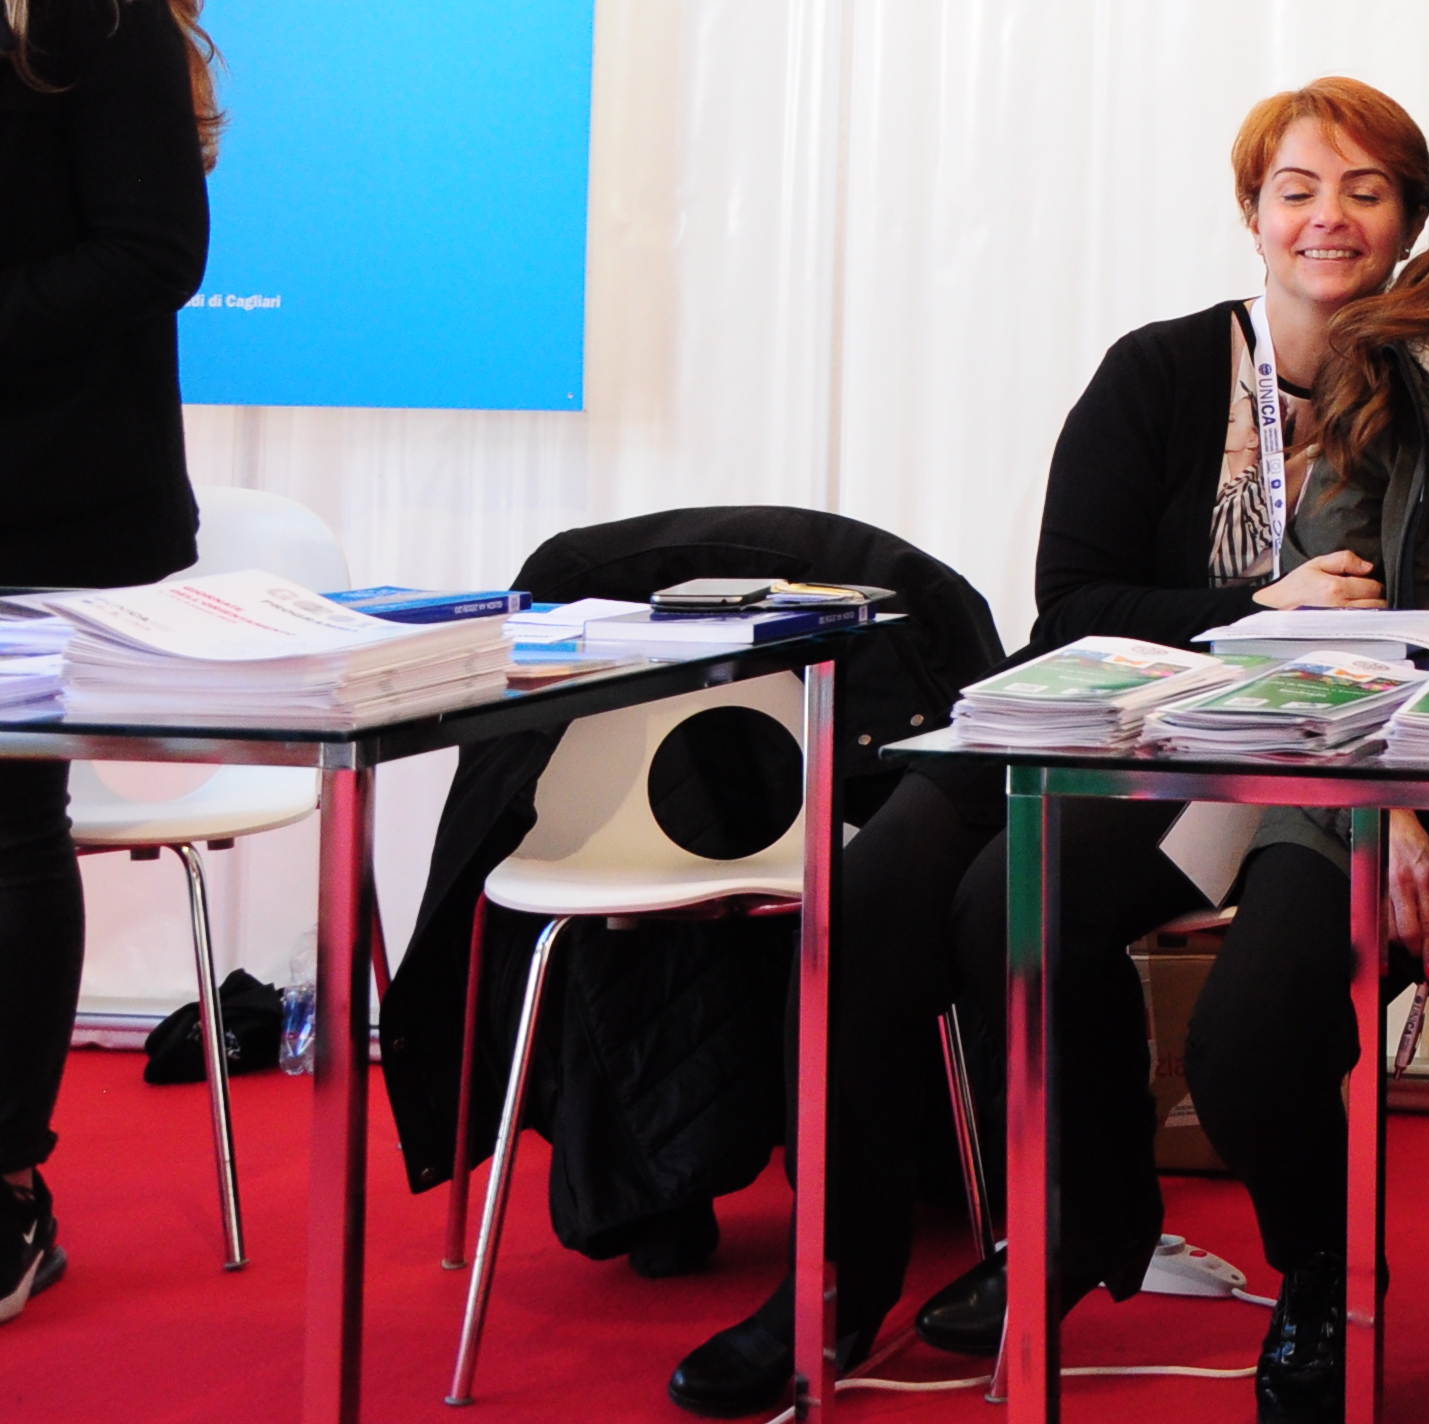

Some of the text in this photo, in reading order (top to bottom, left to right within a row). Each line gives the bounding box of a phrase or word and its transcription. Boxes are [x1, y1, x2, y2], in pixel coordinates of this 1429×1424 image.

[208, 295, 223, 308] di
[226, 294, 281, 311] Cagliari
[1259, 377, 1276, 427] UNICA
